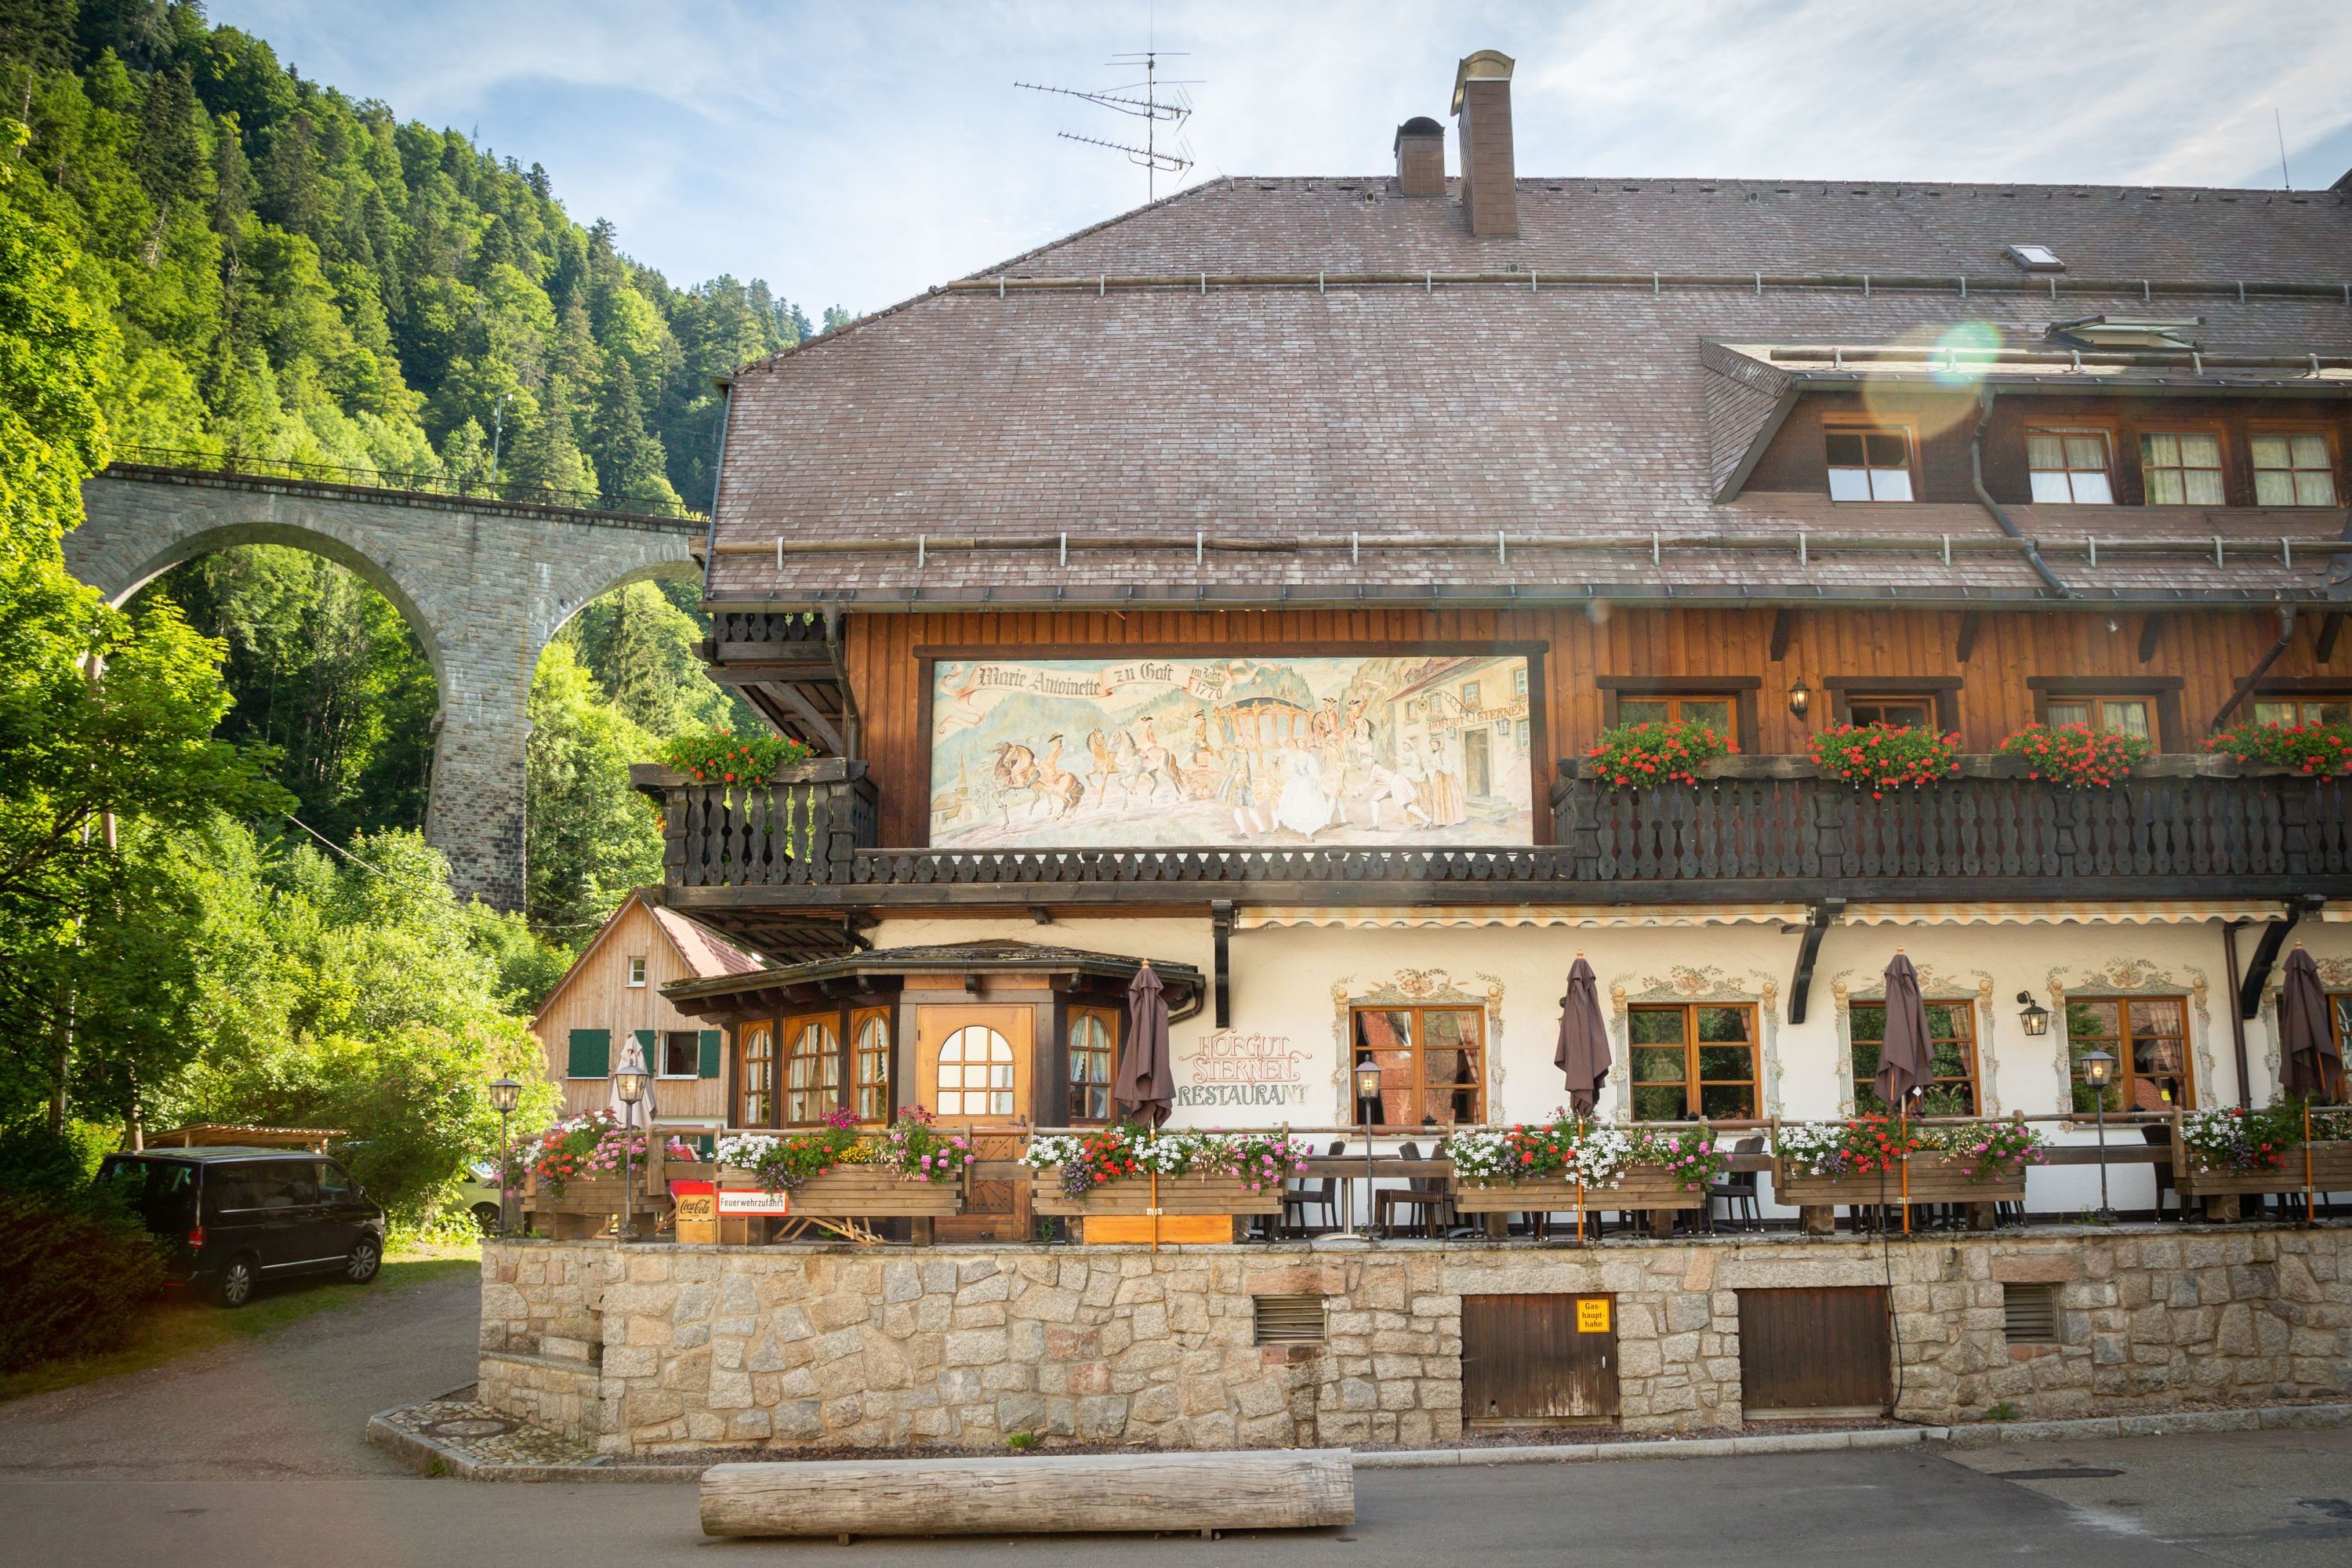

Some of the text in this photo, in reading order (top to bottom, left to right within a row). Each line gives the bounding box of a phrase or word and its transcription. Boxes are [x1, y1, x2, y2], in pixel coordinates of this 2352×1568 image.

[978, 666, 1027, 687] Marie
[1027, 669, 1101, 696] Antoinette
[1114, 668, 1135, 683] zu
[1192, 666, 1221, 681] im Jahr
[1195, 682, 1222, 699] 1770
[1477, 705, 1526, 722] STERNEN
[1198, 1028, 1290, 1060] HOFGUT
[1192, 1057, 1301, 1085] STERNEN
[1177, 1083, 1310, 1106] RESTAURANT
[720, 1197, 783, 1207] Feuerwehrzufahrt
[1581, 1312, 1605, 1320] haupt-
